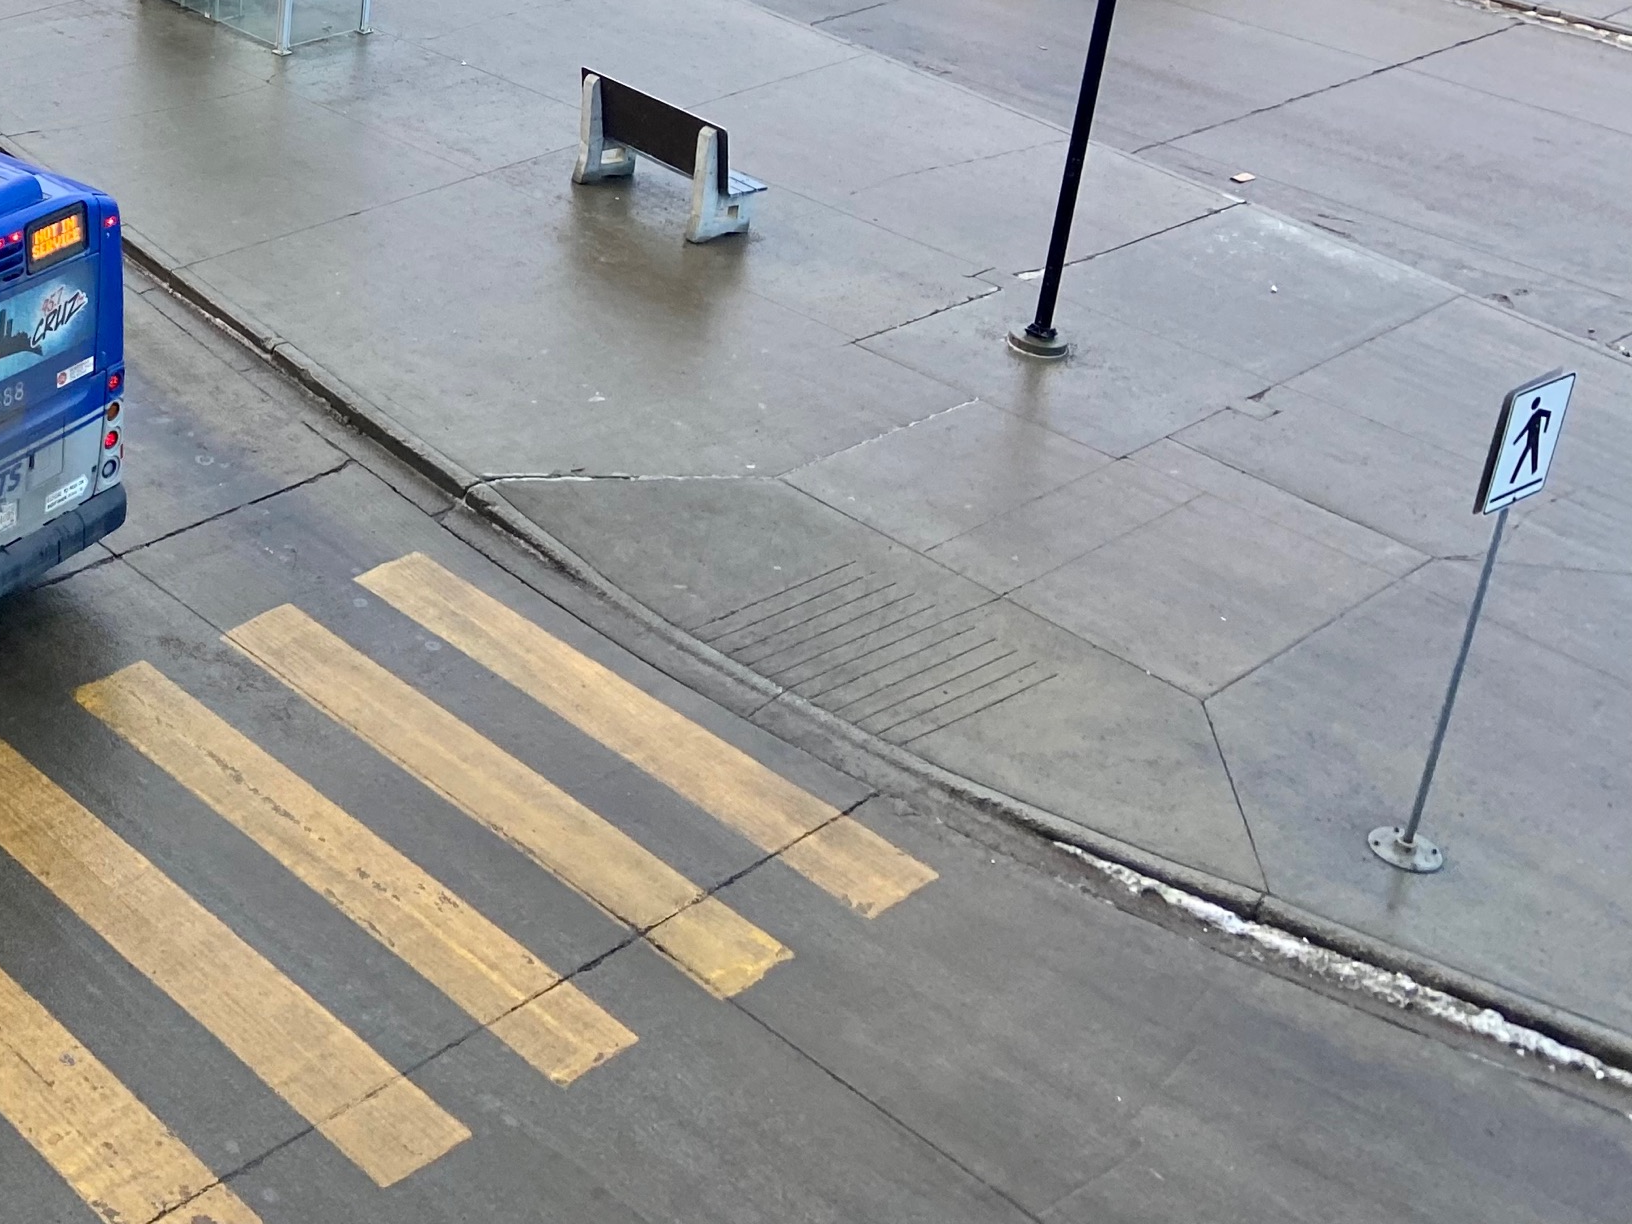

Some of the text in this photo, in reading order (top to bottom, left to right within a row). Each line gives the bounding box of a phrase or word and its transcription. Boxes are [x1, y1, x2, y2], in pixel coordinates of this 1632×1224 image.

[32, 214, 78, 244] NOT IN
[32, 227, 81, 261] SERVICE
[31, 292, 86, 346] CRUZ
